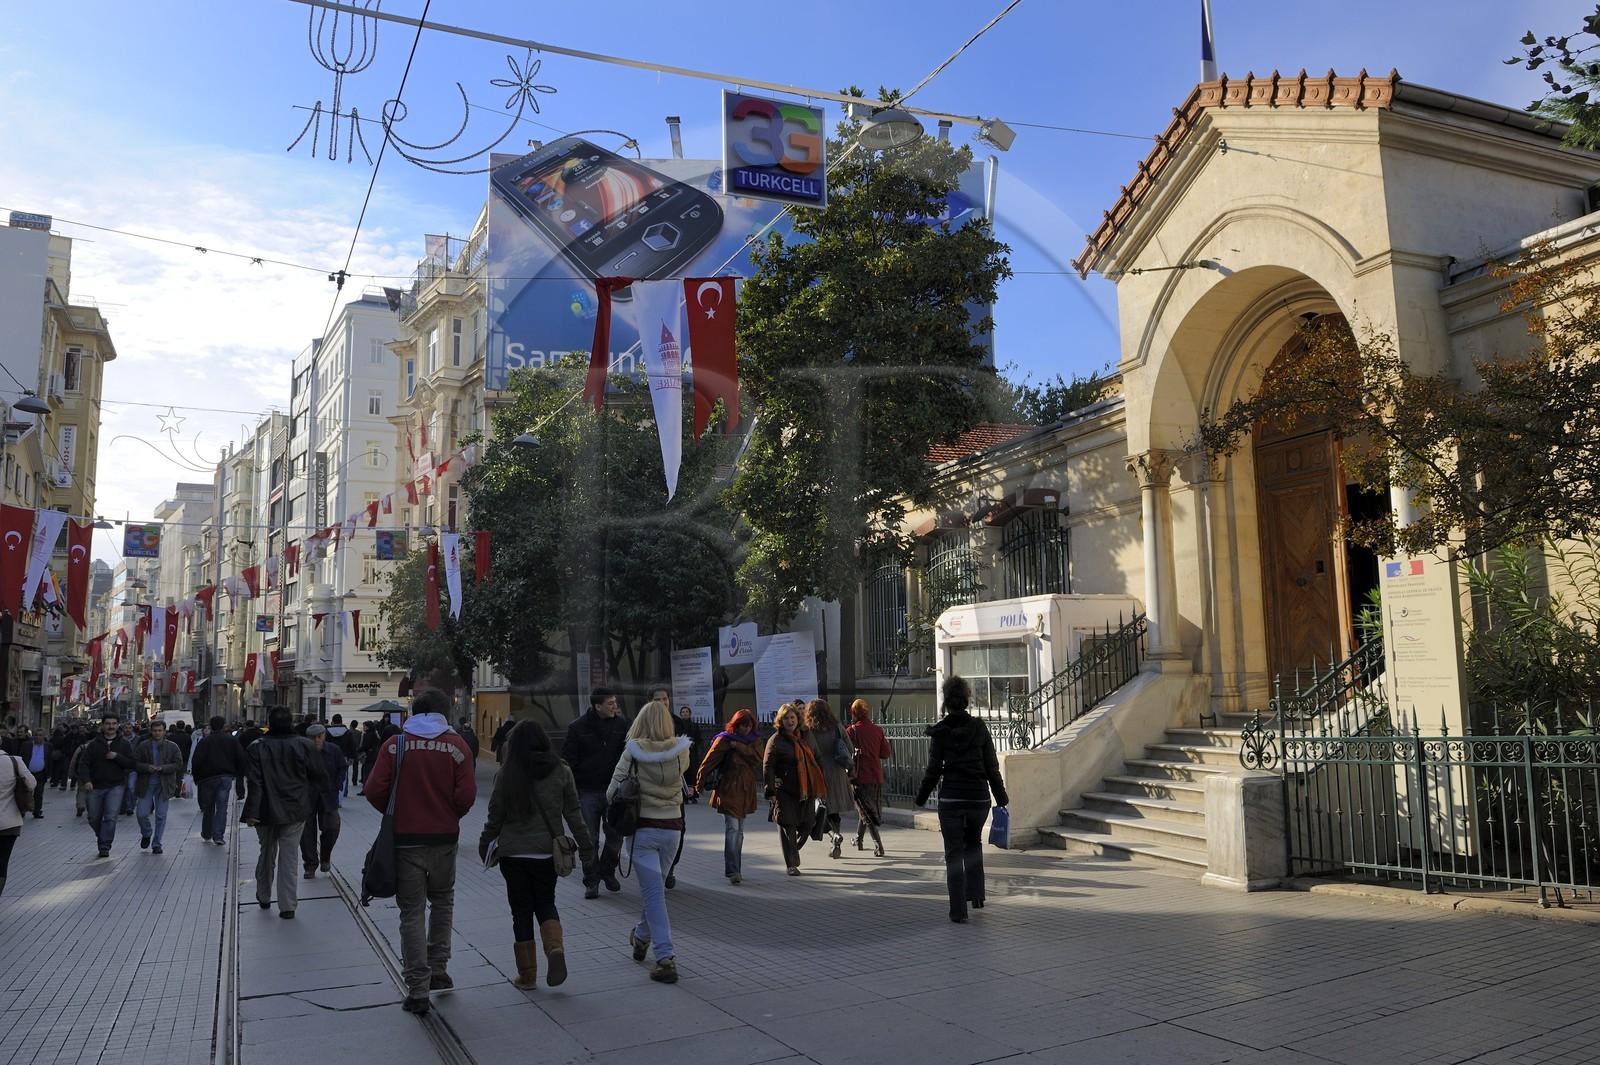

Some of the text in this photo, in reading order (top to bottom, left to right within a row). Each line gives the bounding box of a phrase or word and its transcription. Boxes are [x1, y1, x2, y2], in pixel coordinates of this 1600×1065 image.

[732, 98, 819, 175] 3G
[739, 170, 819, 195] TURKCELL
[11, 212, 49, 223] SQUARE
[127, 526, 159, 549] 3G
